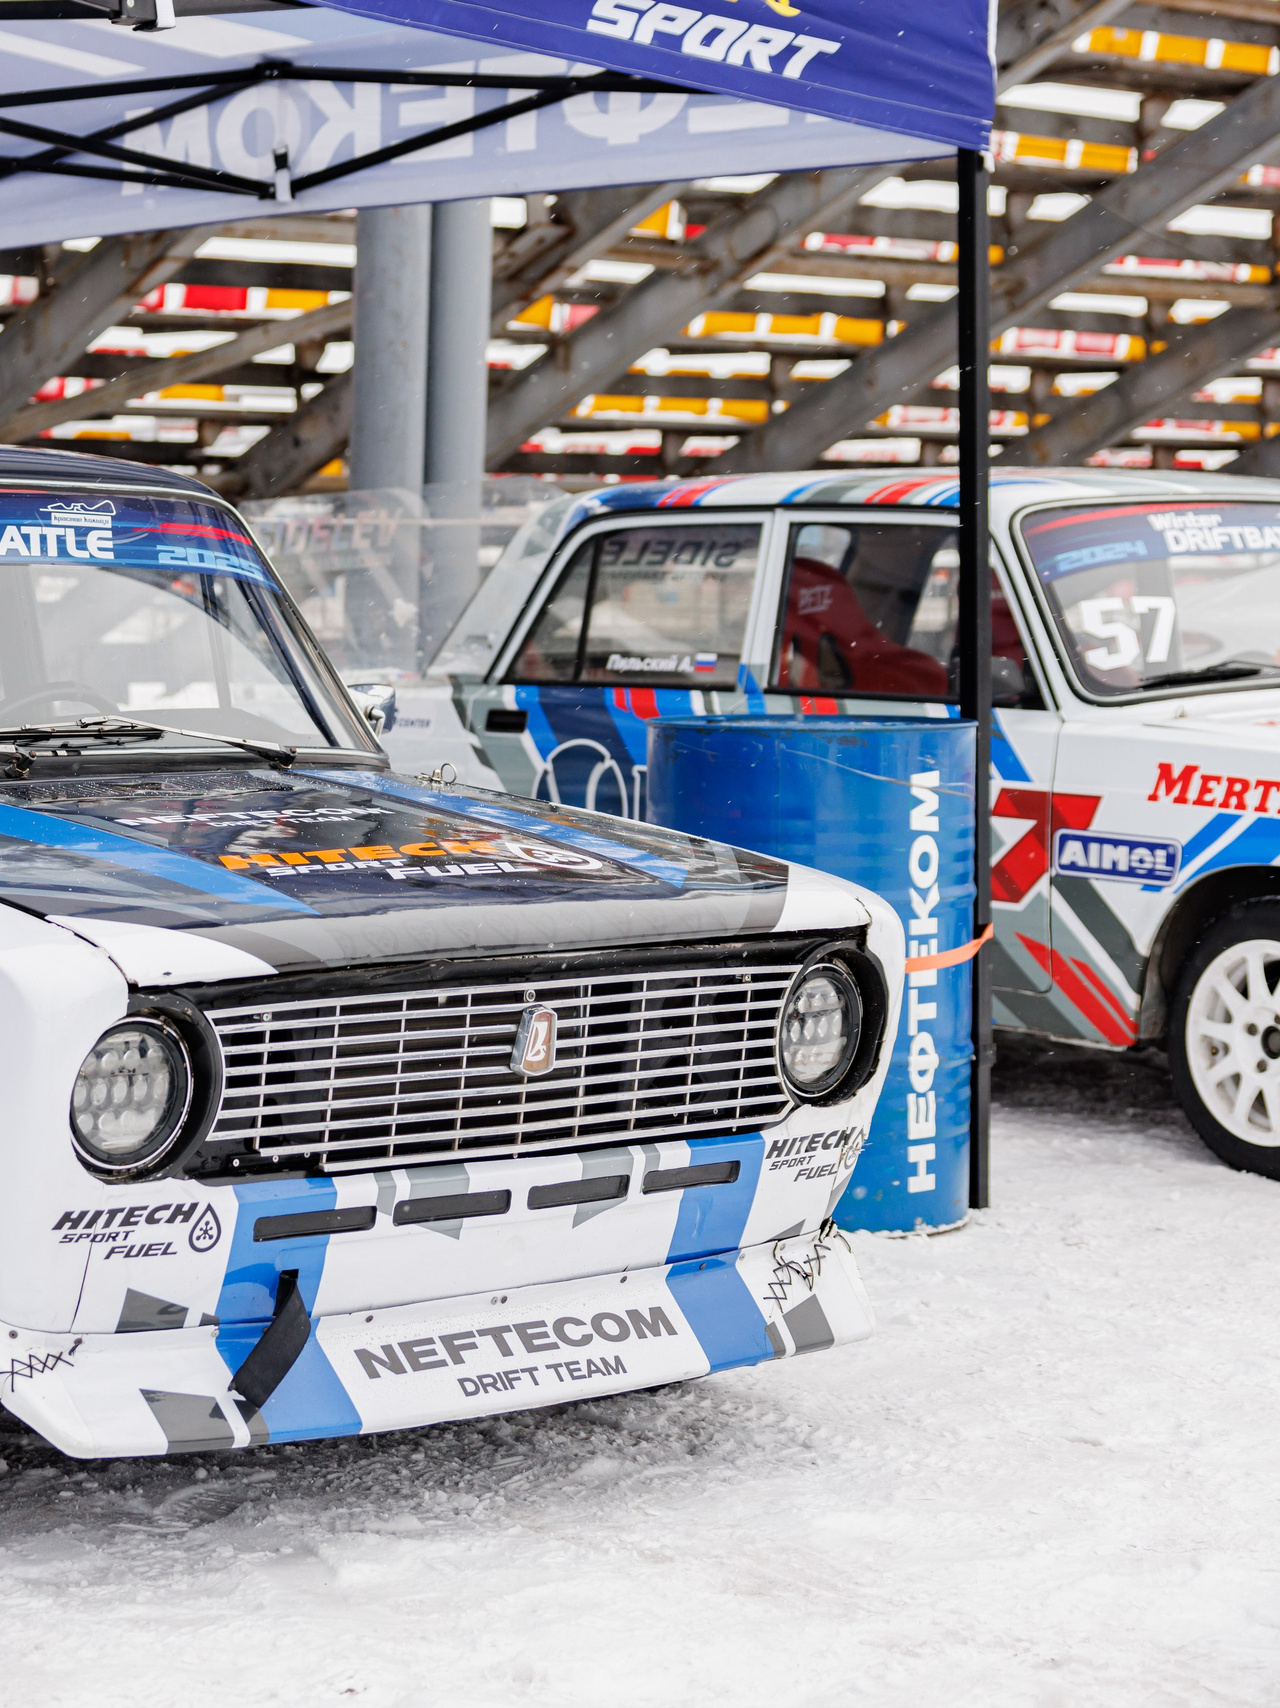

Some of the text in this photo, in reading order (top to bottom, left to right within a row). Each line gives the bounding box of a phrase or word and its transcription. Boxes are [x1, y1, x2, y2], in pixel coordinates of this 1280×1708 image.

[586, 0, 842, 79] SPORT
[1147, 511, 1223, 532] Winter
[156, 545, 265, 581] 2025
[1056, 539, 1149, 572] 2024
[1077, 595, 1177, 671] 57
[1147, 762, 1280, 815] MERT
[115, 807, 397, 826] NEFTECOM
[218, 839, 500, 871] HITECH
[266, 858, 409, 877] SPORT
[386, 861, 539, 880] FUEL
[1059, 839, 1175, 877] AIMOL
[907, 770, 940, 1193] НЕФТЕКОМ
[764, 1126, 857, 1160] HITECH
[769, 1155, 816, 1171] SPORT
[793, 1163, 838, 1182] FUEL
[51, 1201, 200, 1231] HITECH
[58, 1229, 136, 1244] SPORT
[103, 1241, 178, 1260] FUEL
[353, 1306, 679, 1380] NEFTECOM
[457, 1355, 628, 1397] DRIFT TEAM
